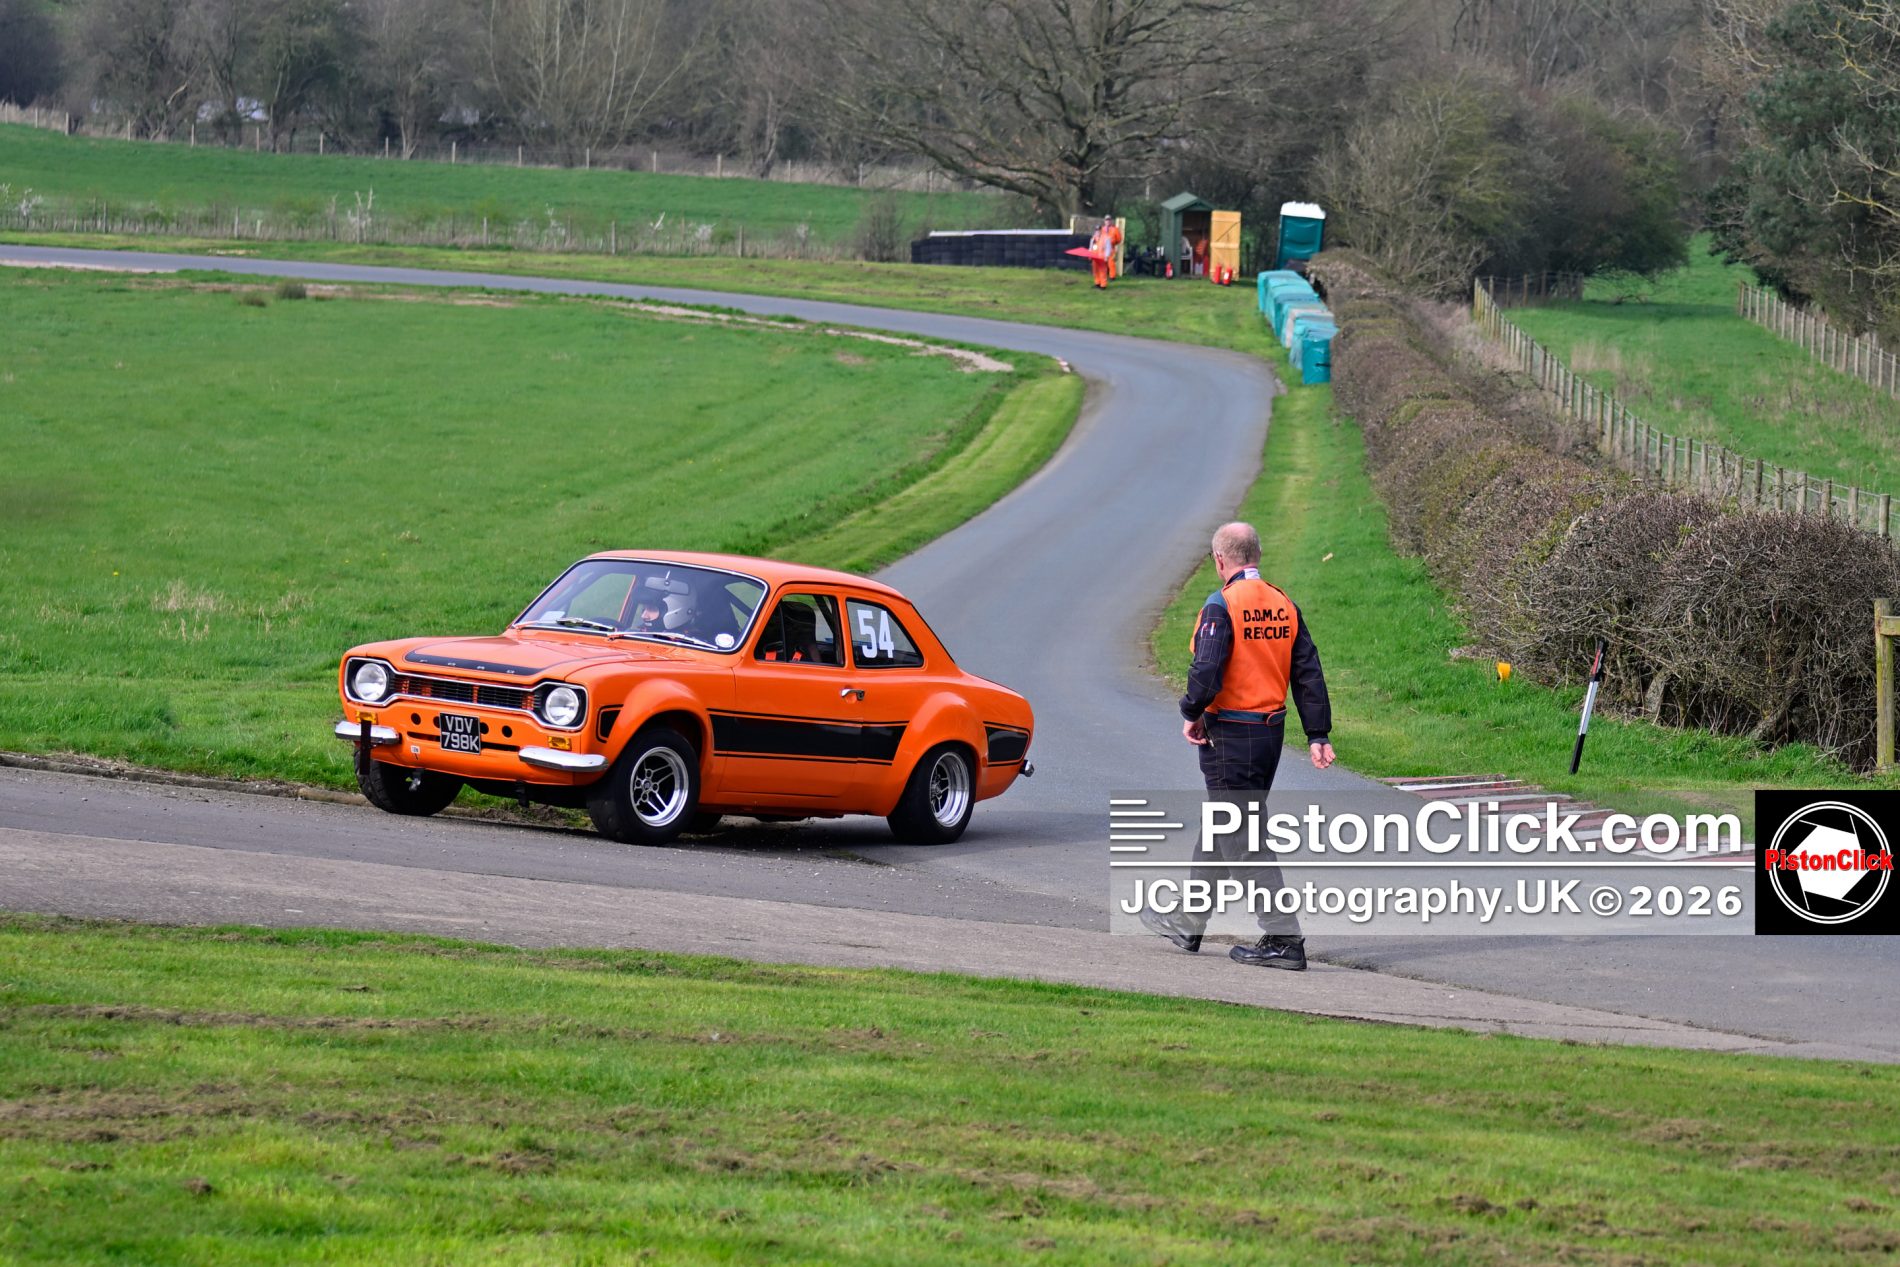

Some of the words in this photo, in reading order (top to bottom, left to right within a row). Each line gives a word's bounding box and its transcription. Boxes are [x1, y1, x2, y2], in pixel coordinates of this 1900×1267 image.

[857, 609, 895, 658] 54
[445, 715, 474, 734] VDV
[441, 731, 479, 751] 798K
